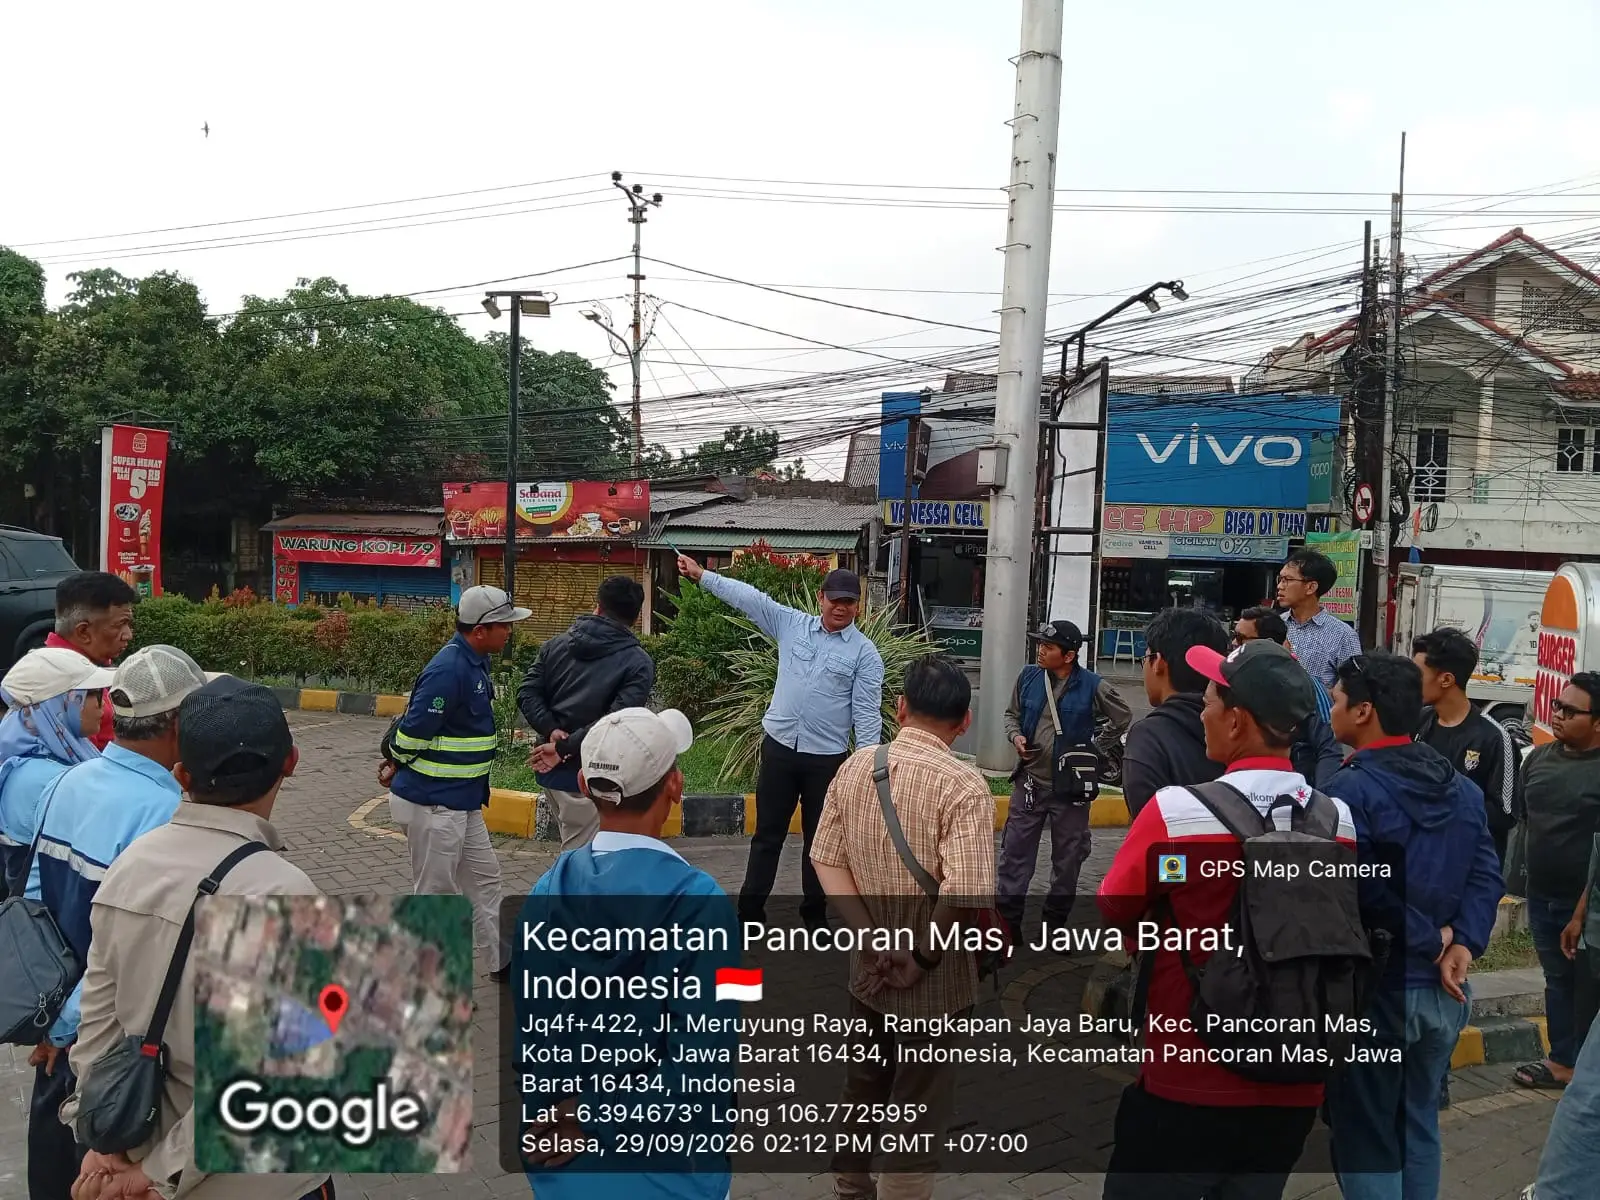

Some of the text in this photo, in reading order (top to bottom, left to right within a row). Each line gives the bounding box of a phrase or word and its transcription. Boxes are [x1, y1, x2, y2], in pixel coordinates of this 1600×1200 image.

[884, 440, 907, 450] viv
[1136, 422, 1302, 467] vivo
[112, 456, 162, 468] SUPER HEMAT
[1310, 462, 1330, 479] oppo
[129, 468, 148, 499] 5
[148, 469, 160, 480] RB
[955, 502, 984, 527] CELL
[1157, 508, 1214, 533] HP
[1224, 510, 1255, 535] BISA
[1259, 512, 1273, 536] DI
[279, 536, 436, 556] WARUNG KOPI 79
[1174, 536, 1217, 547] CICILAN
[1219, 537, 1251, 555] 0%
[936, 635, 977, 647] oppo
[1537, 631, 1577, 676] BURGER
[1533, 670, 1570, 726] KIN
